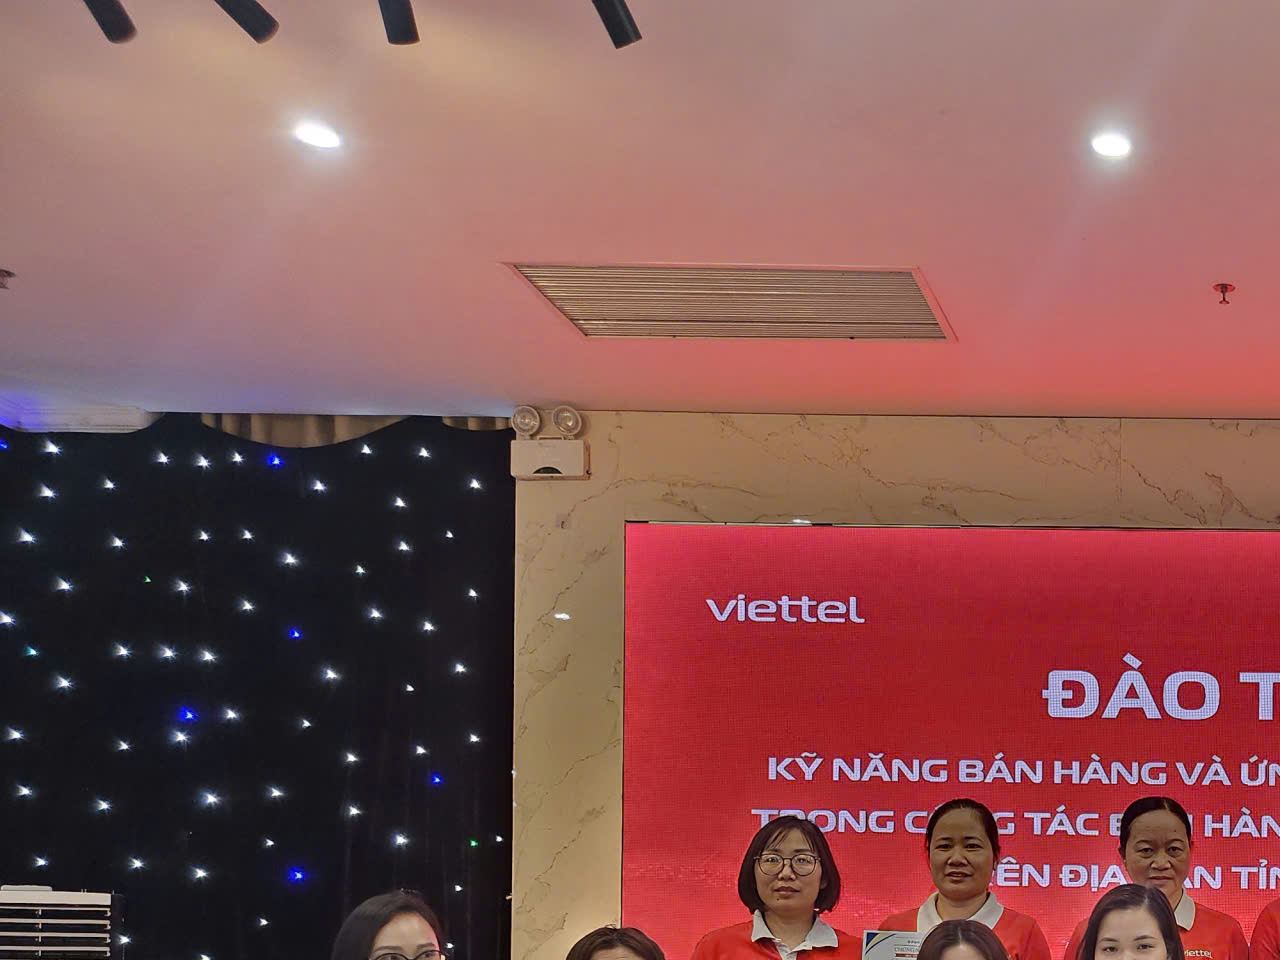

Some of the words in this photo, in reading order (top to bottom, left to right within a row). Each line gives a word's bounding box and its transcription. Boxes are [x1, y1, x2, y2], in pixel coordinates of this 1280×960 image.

[705, 594, 866, 624] viettel
[1042, 653, 1221, 721] ĐÀO
[768, 752, 824, 781] KỸ
[832, 752, 949, 783] NĂNG
[958, 752, 1044, 784] BÁN
[1053, 753, 1168, 785] HÀNG
[1175, 754, 1232, 786] VÀ
[1023, 804, 1100, 836] TÁC
